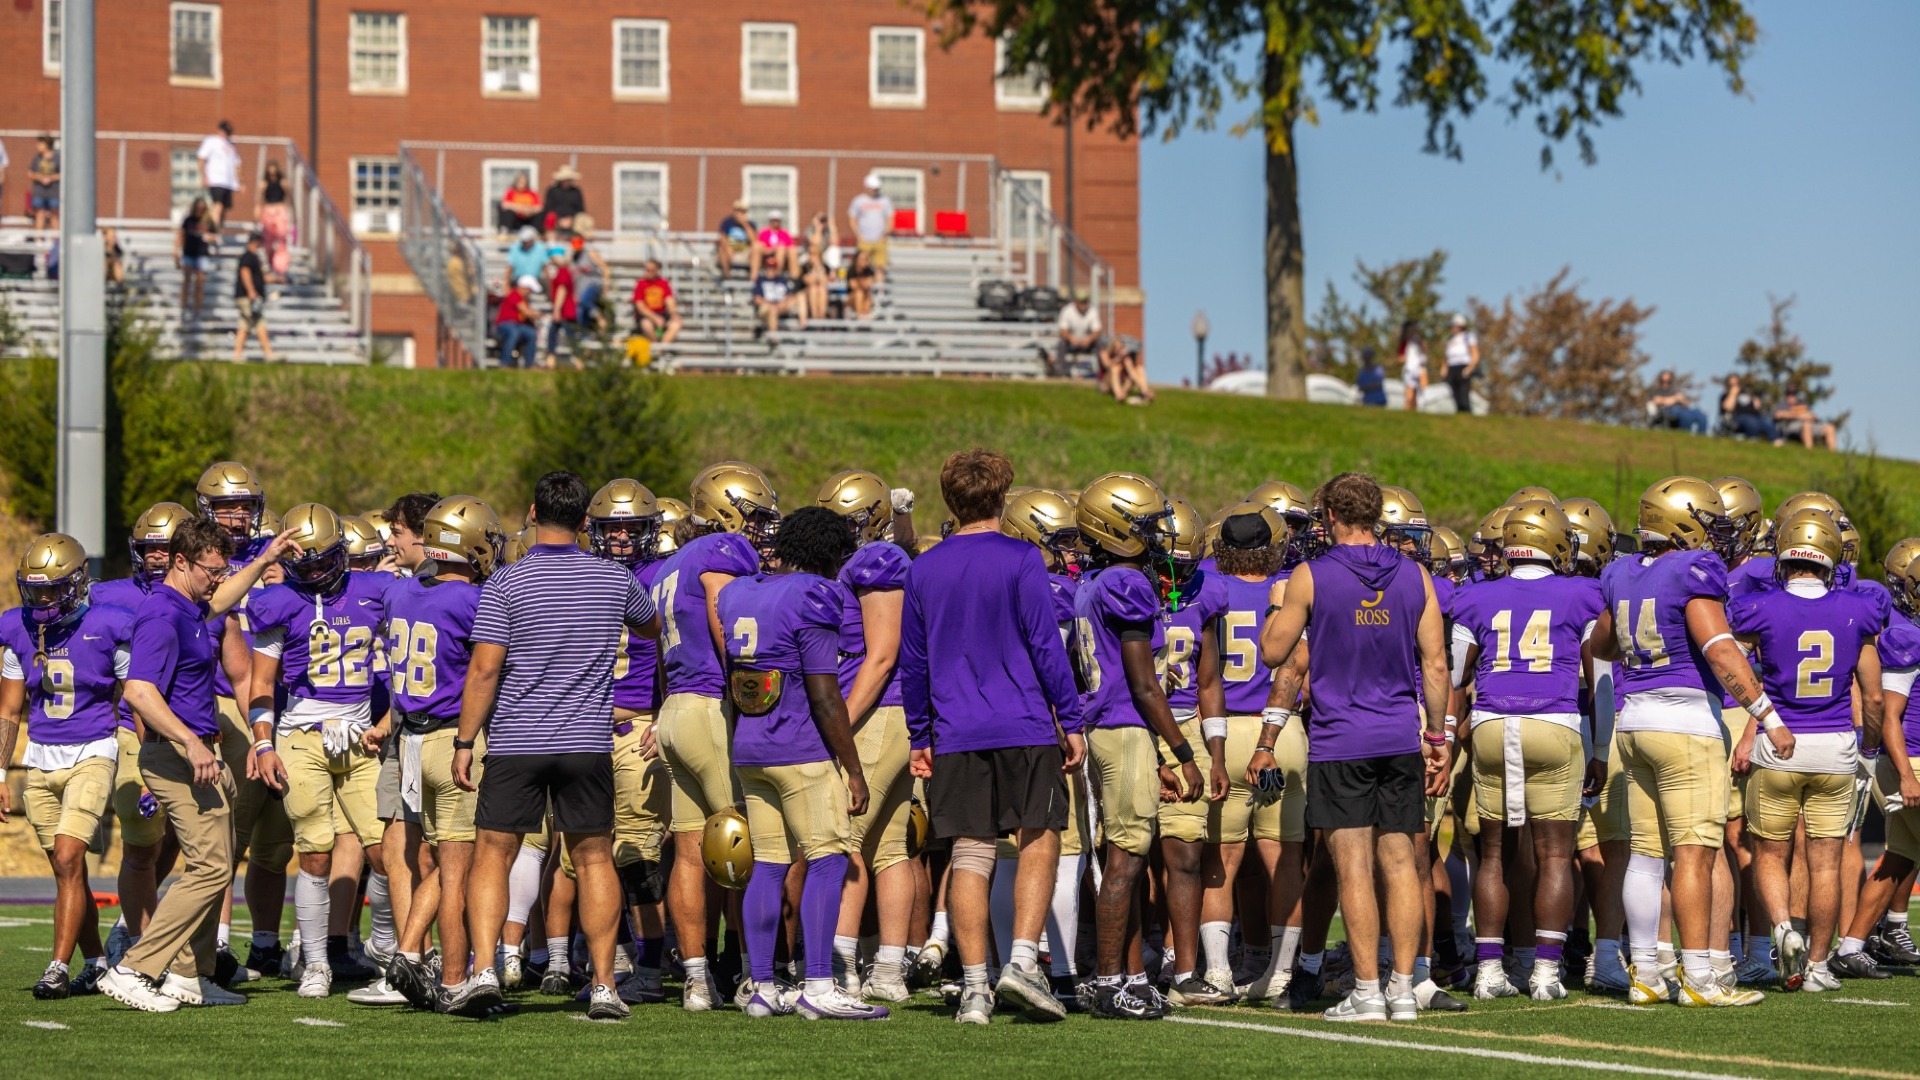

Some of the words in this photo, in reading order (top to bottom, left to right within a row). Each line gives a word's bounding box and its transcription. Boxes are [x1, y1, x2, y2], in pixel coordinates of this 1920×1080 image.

[424, 550, 448, 560] ddell
[1504, 549, 1533, 558] Riddell
[1790, 549, 1825, 561] Riddell
[332, 616, 351, 626] LORAS
[1222, 610, 1279, 682] 5
[1355, 609, 1390, 626] ROSS
[1491, 610, 1554, 673] 14
[307, 626, 372, 687] 82
[389, 617, 438, 698] 28
[1795, 629, 1835, 699] 2
[43, 658, 75, 719] 9
